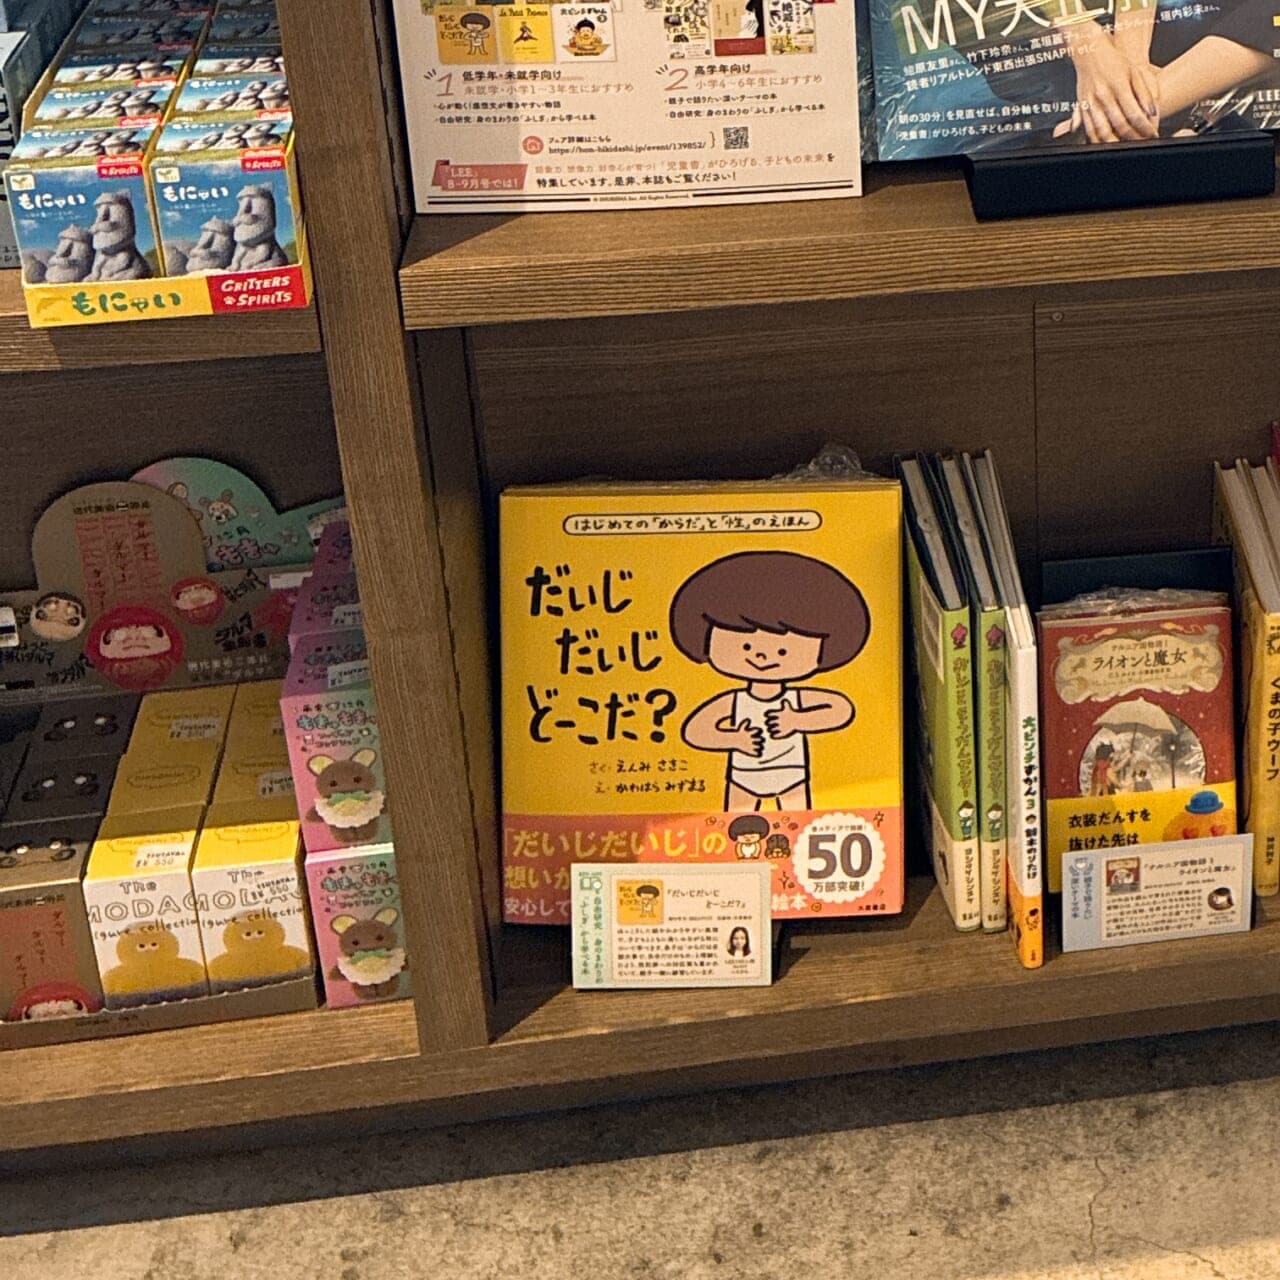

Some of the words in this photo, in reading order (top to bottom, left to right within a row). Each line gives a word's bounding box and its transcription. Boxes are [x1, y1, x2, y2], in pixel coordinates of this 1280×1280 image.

[664, 68, 689, 91] 2
[695, 64, 751, 75] 高学年向け
[437, 73, 454, 97] 1
[18, 192, 87, 210] もにゃい
[163, 185, 229, 203] もにゃい
[72, 291, 182, 316] もにゃい
[525, 565, 633, 617] だいじ
[555, 628, 663, 675] だいじ
[1092, 648, 1188, 671] ライオンと魔女
[616, 760, 651, 773] えんみ
[615, 780, 661, 794] かわはら
[664, 779, 707, 793] みずまる
[1068, 809, 1151, 829] 衣装だんすを
[1068, 832, 1139, 851] 抜けた先は
[806, 833, 873, 880] 50
[120, 881, 157, 895] The
